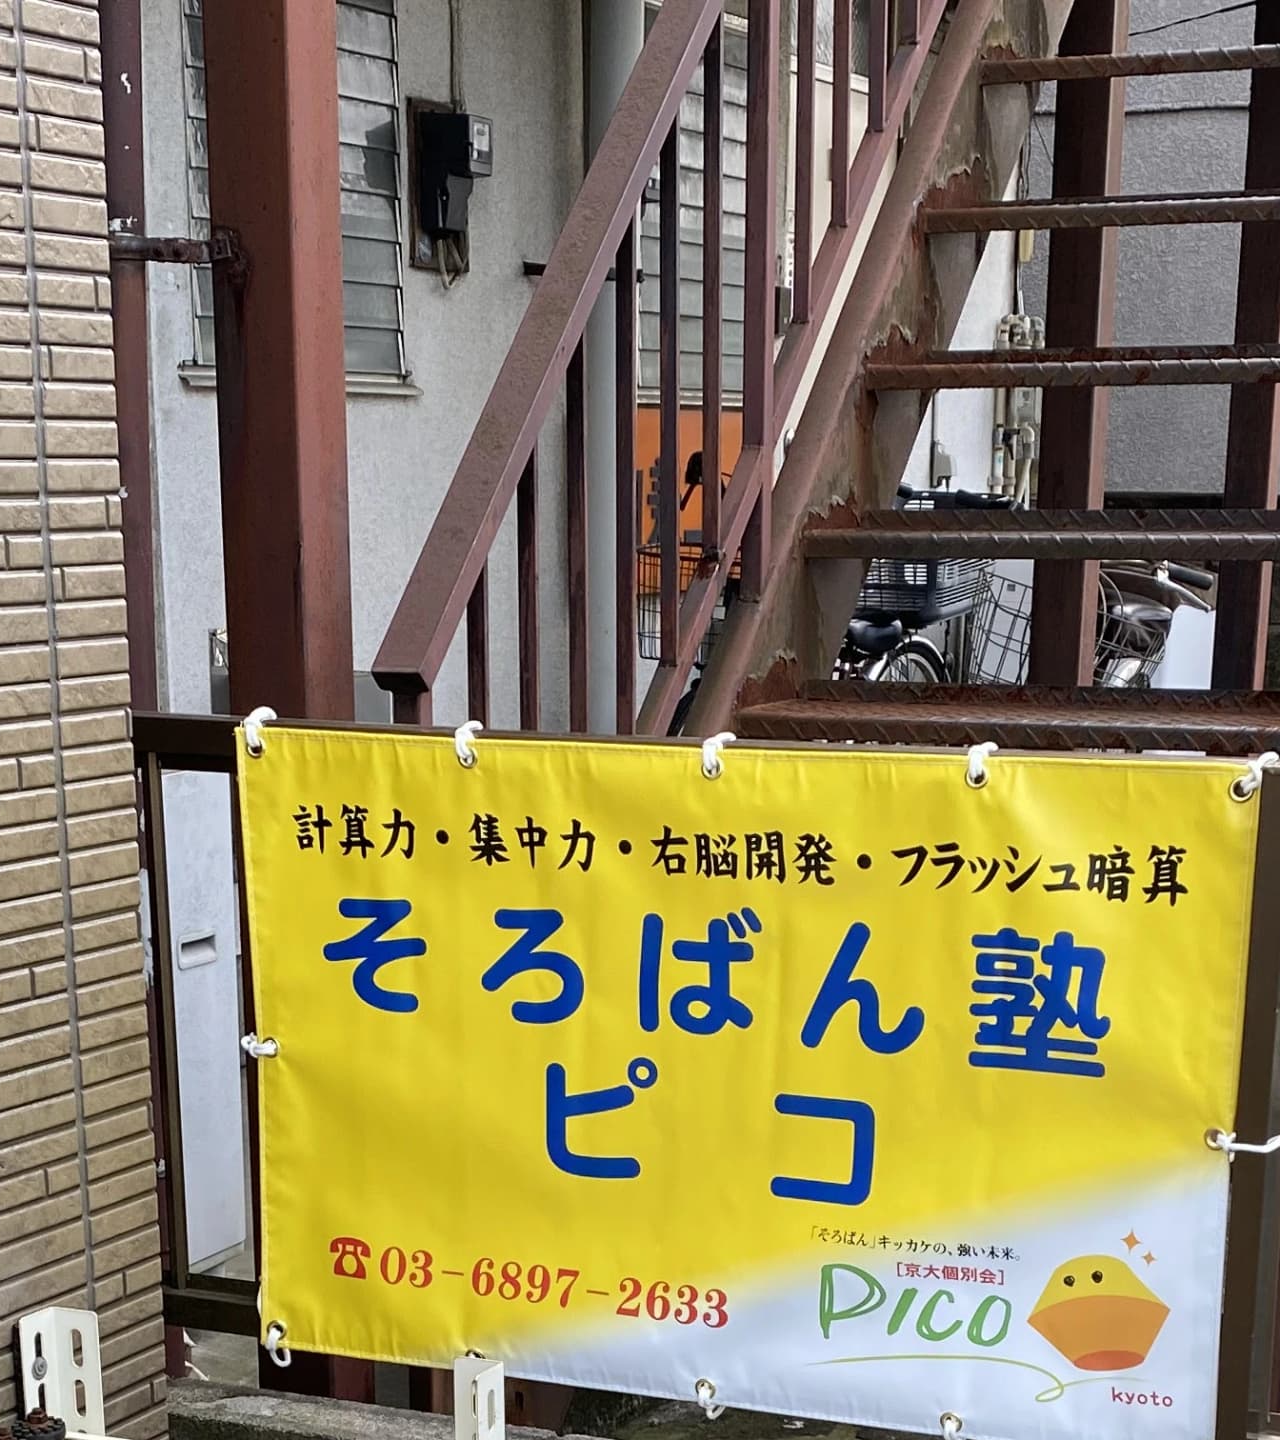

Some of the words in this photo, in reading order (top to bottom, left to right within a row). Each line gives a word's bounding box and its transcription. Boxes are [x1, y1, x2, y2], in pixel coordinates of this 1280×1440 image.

[291, 803, 1190, 907] 計算力・集中力・右脳開発・フラッシュ暗算
[322, 896, 1111, 1079] そろばん塾
[545, 1056, 874, 1205] ピコ
[379, 1245, 730, 1329] 03-6897-2633
[1110, 1386, 1174, 1407] kyoto
